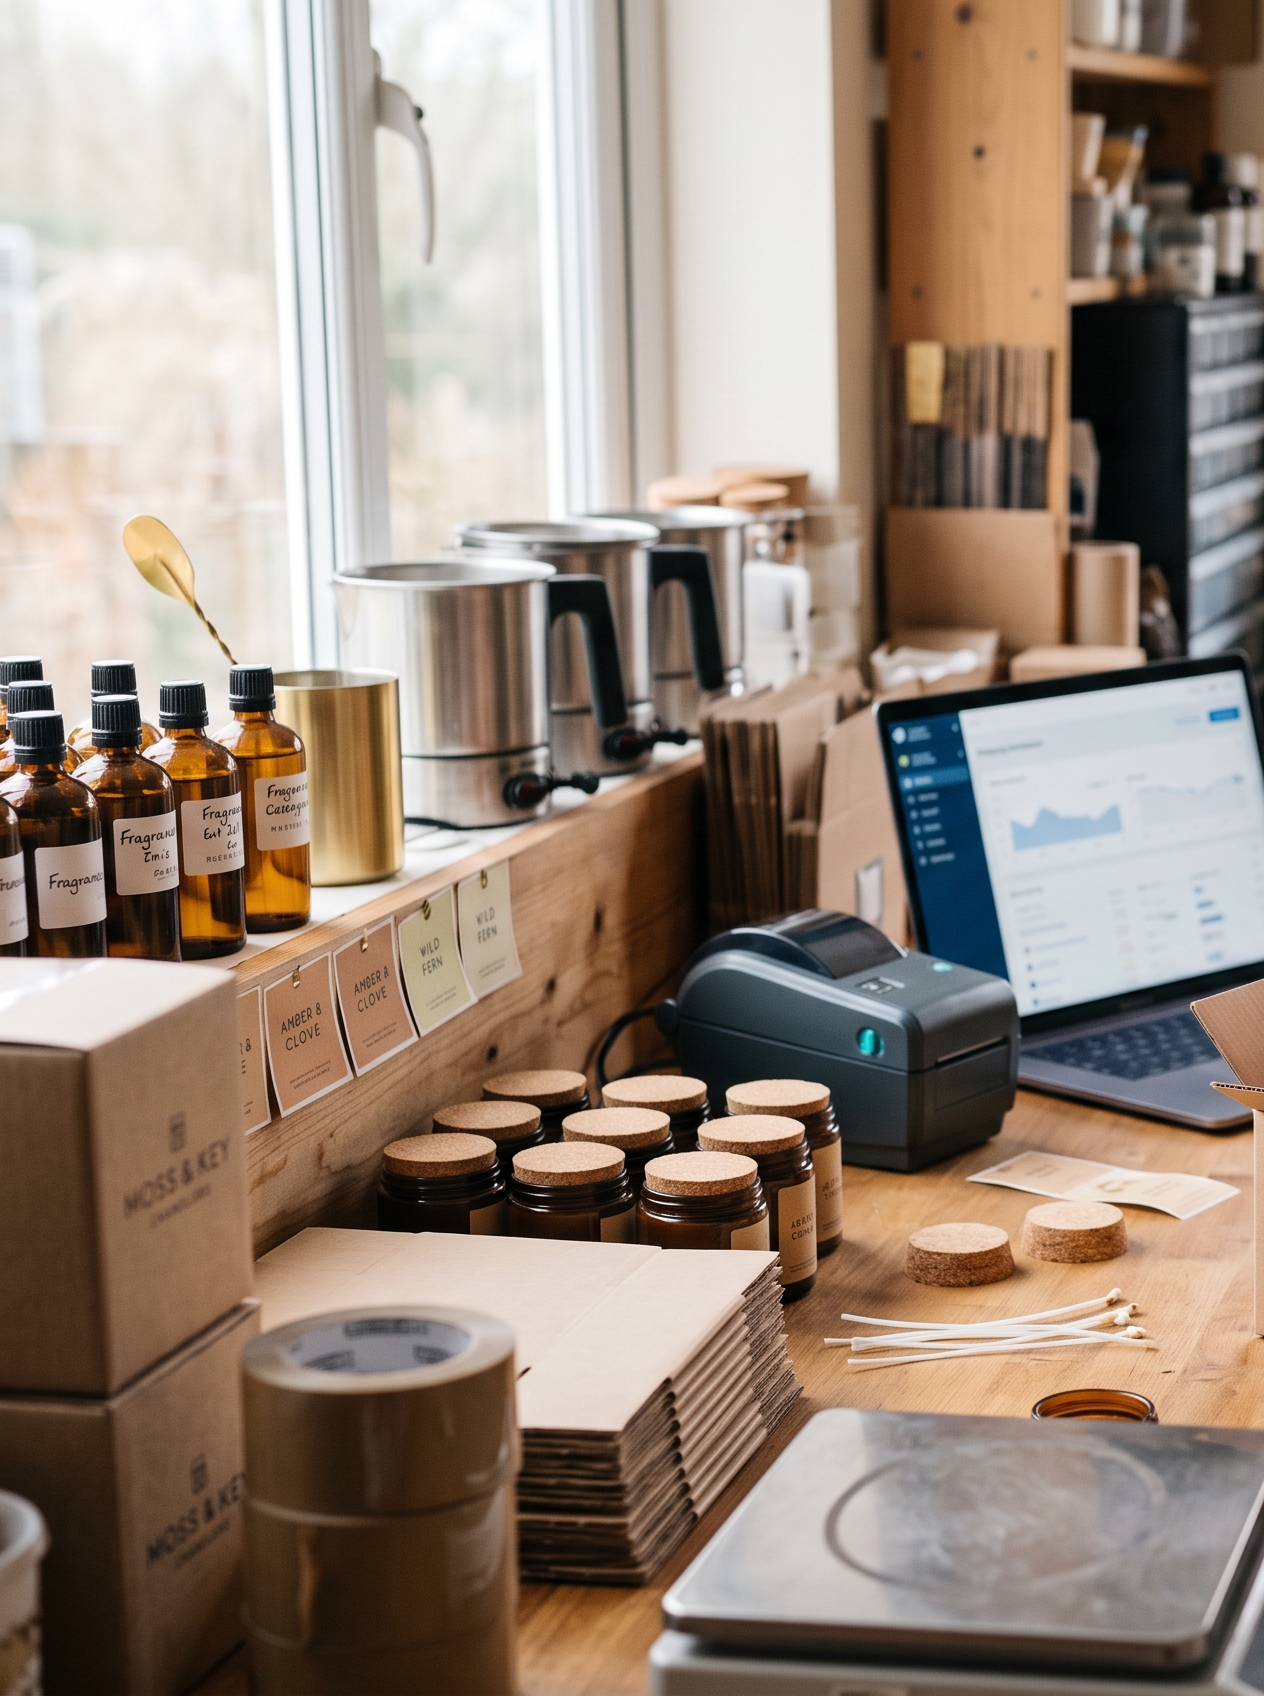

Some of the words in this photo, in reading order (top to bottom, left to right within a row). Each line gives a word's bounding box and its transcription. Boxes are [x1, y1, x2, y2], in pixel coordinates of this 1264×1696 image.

[476, 907, 496, 925] WILD
[477, 925, 498, 944] FERN
[419, 937, 440, 958] WILD
[422, 955, 443, 976] FERN
[354, 970, 382, 996] AMBER
[357, 986, 388, 1013] CLOVE
[281, 1007, 313, 1035] AMBER
[285, 1022, 321, 1051] CLOVE
